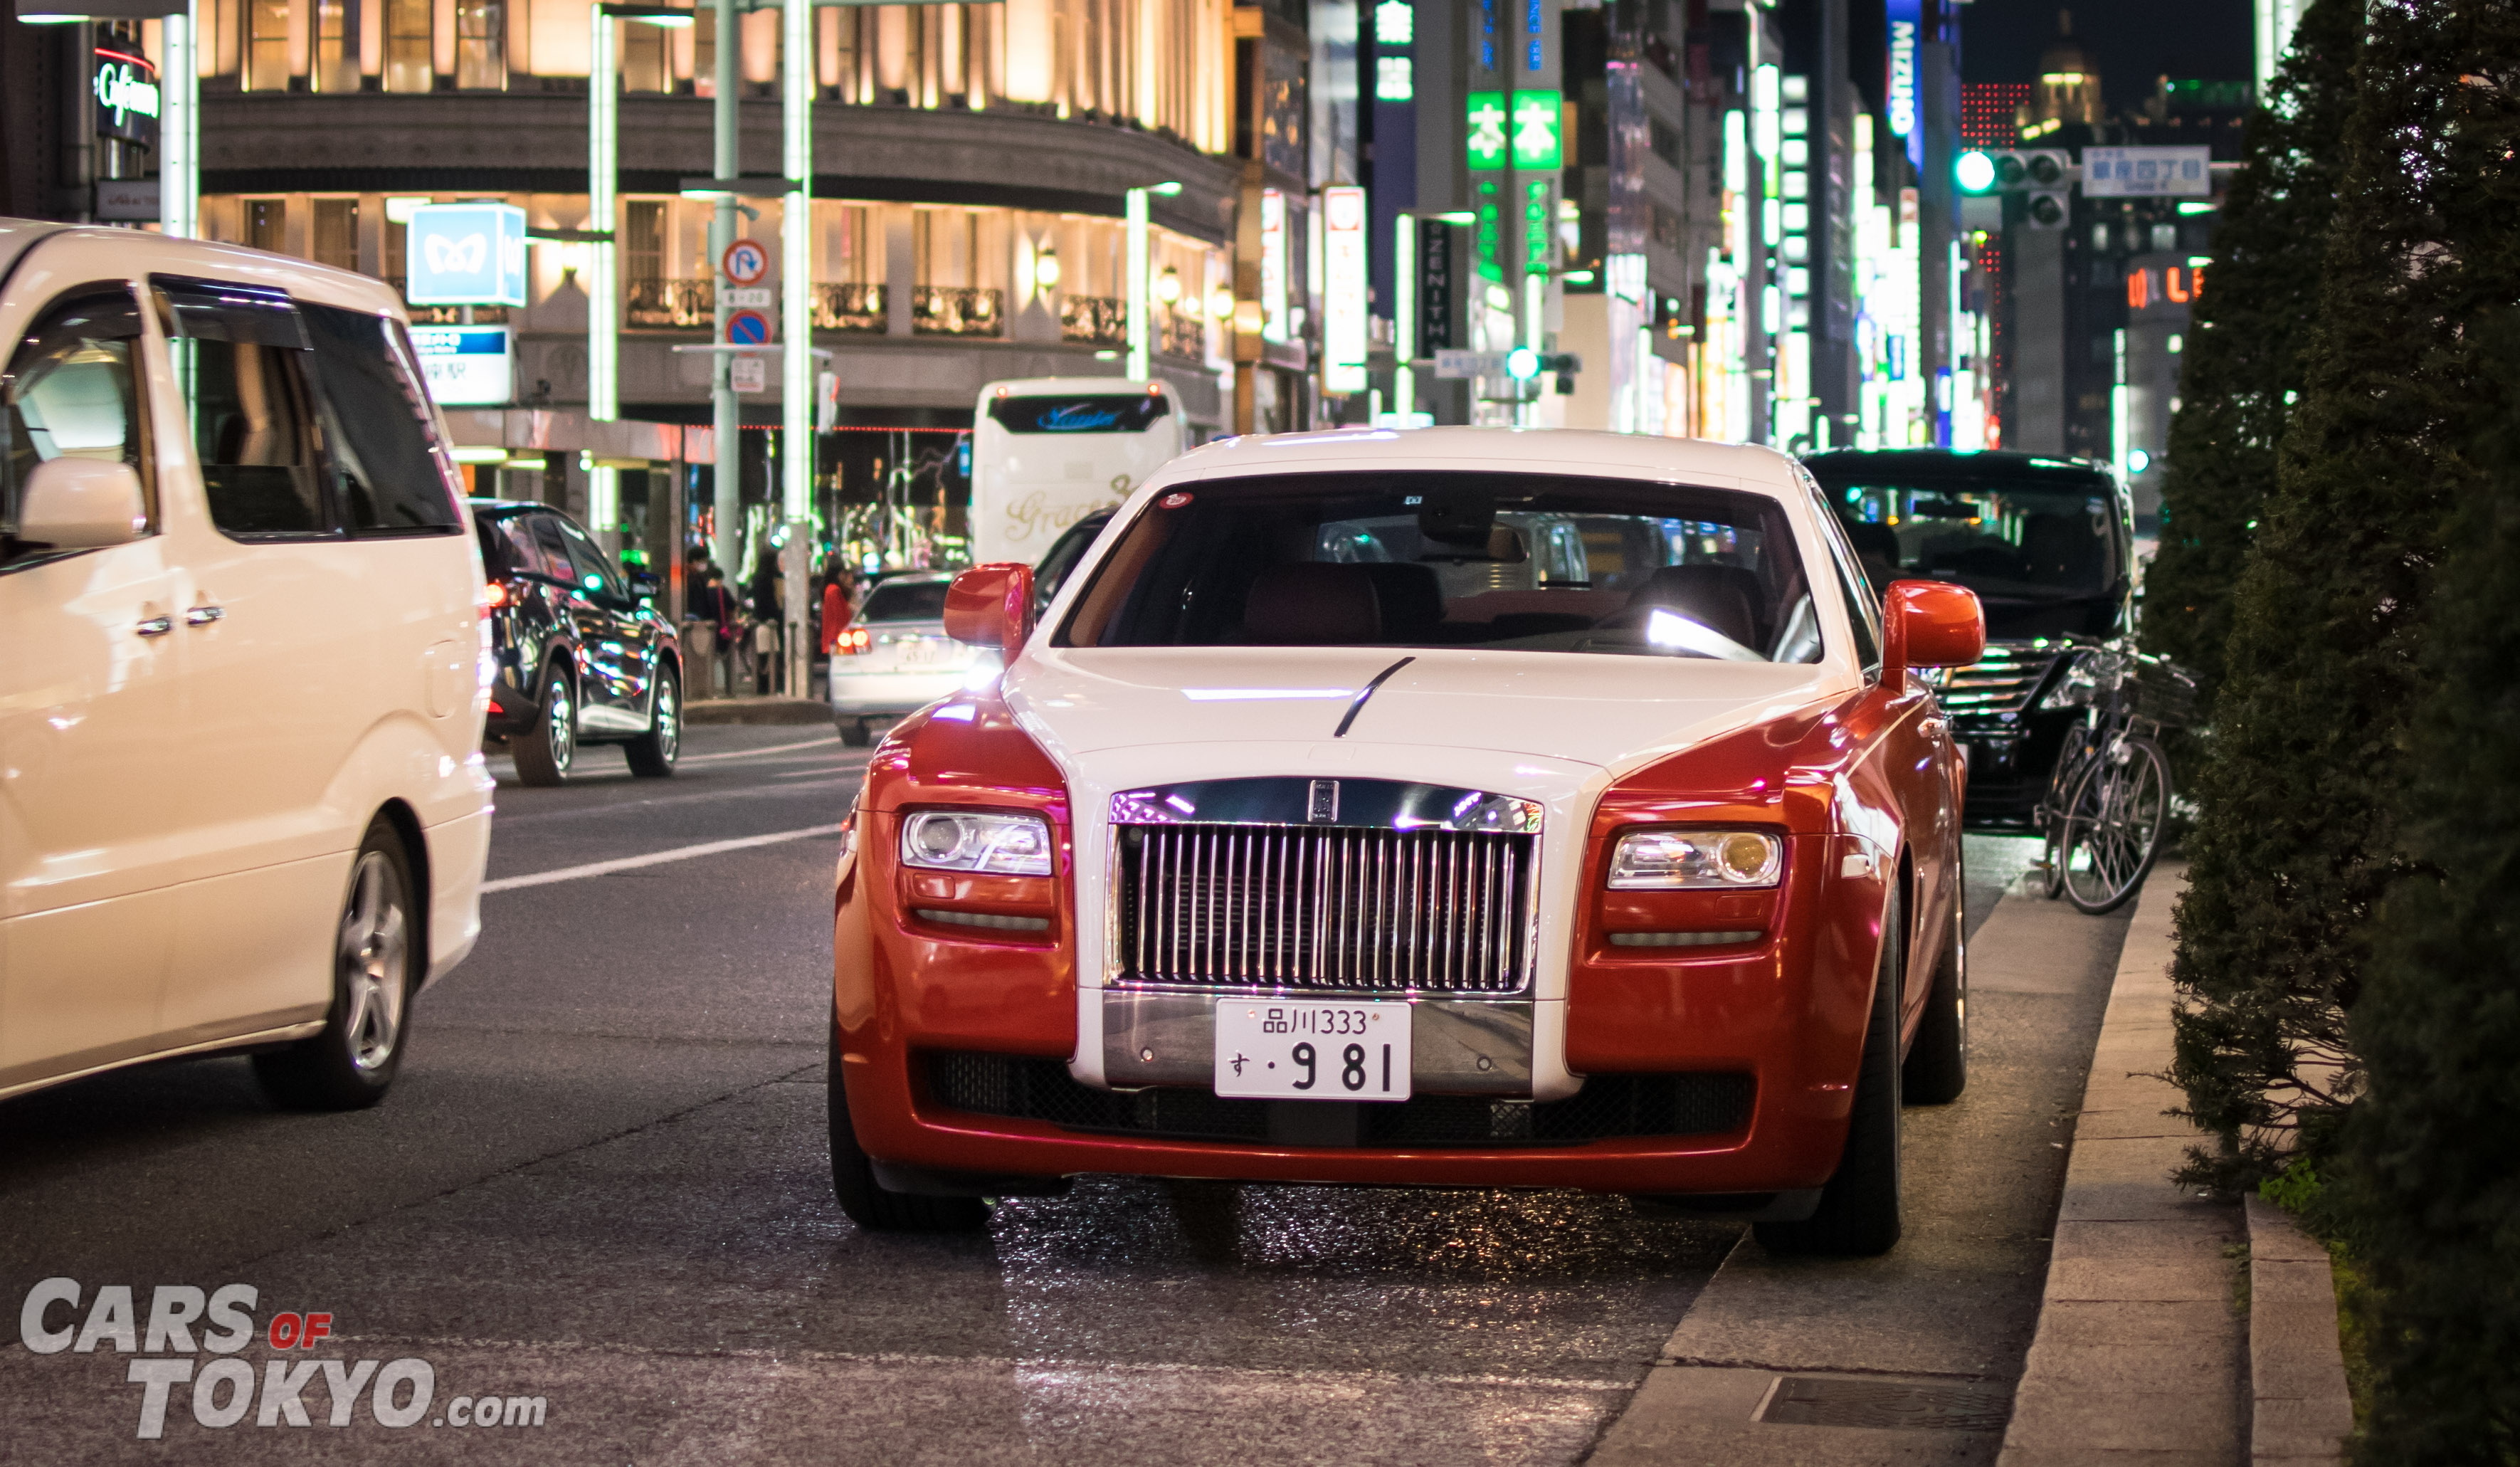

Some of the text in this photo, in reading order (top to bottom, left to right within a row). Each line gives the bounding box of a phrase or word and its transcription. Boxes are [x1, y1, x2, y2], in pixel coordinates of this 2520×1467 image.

[1891, 21, 1914, 135] MIZUHO
[1513, 102, 1556, 158] 本
[1228, 1052, 1250, 1078] す
